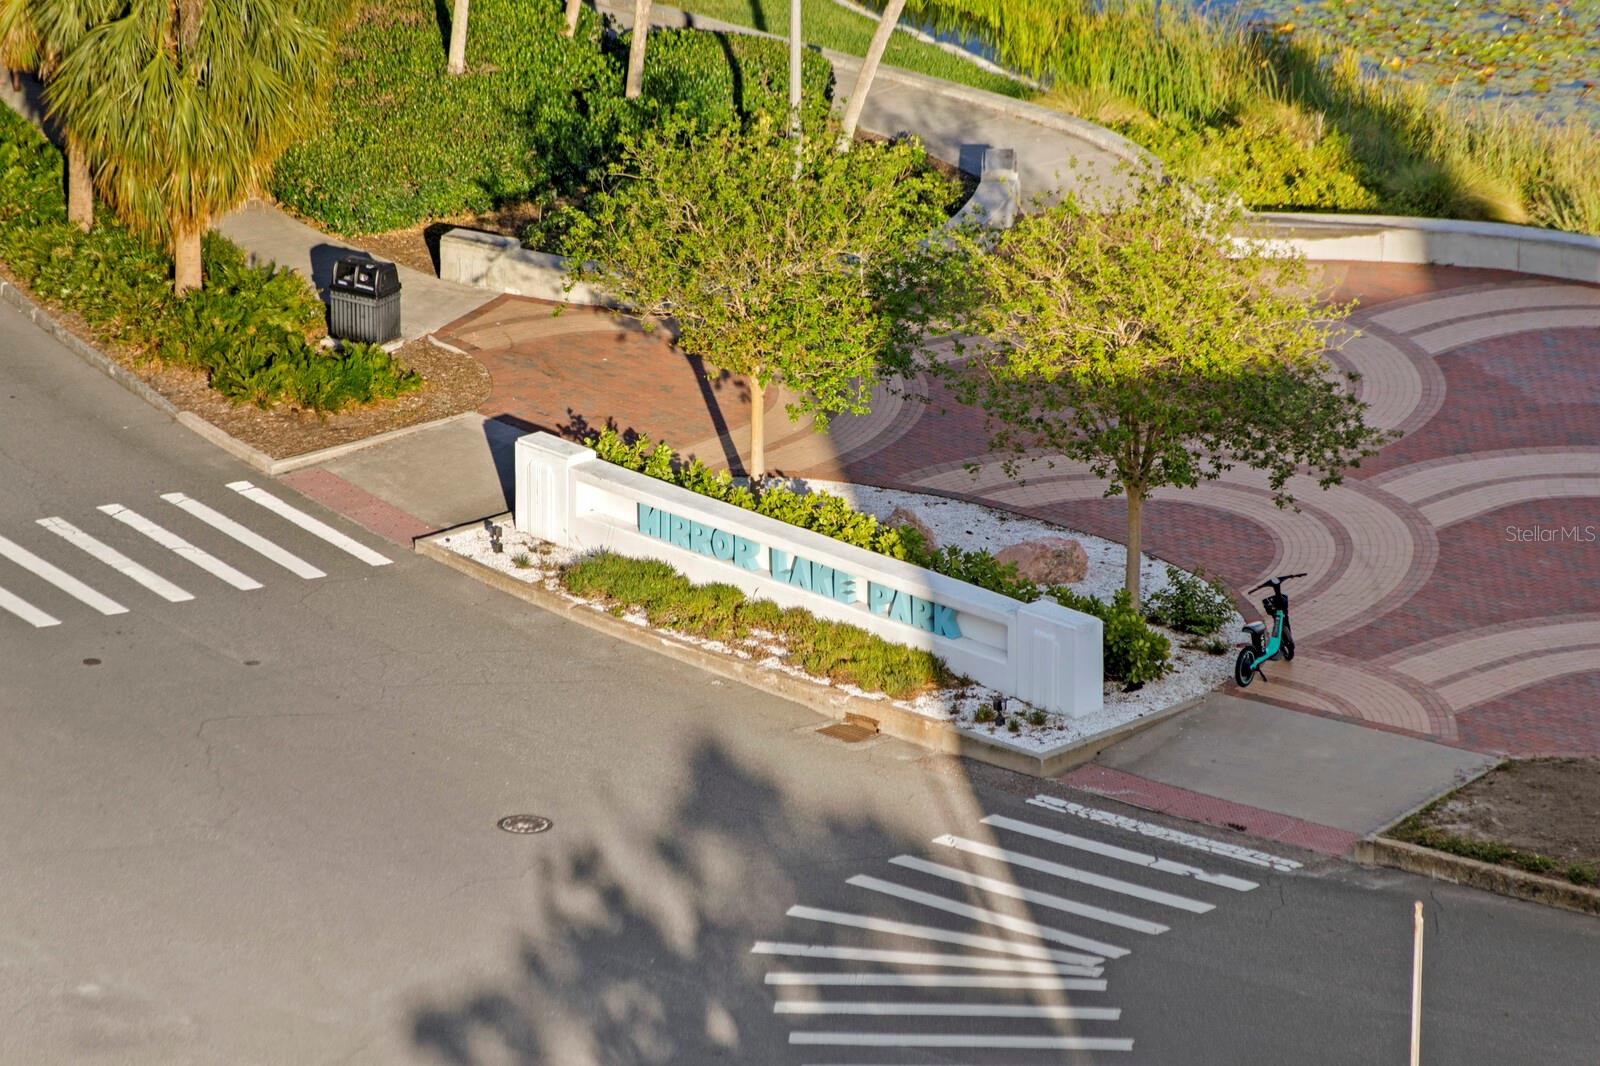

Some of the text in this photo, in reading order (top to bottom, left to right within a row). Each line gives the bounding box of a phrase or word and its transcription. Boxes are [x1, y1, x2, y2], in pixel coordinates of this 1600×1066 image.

[637, 502, 960, 639] MIRROR LAKE PARK
